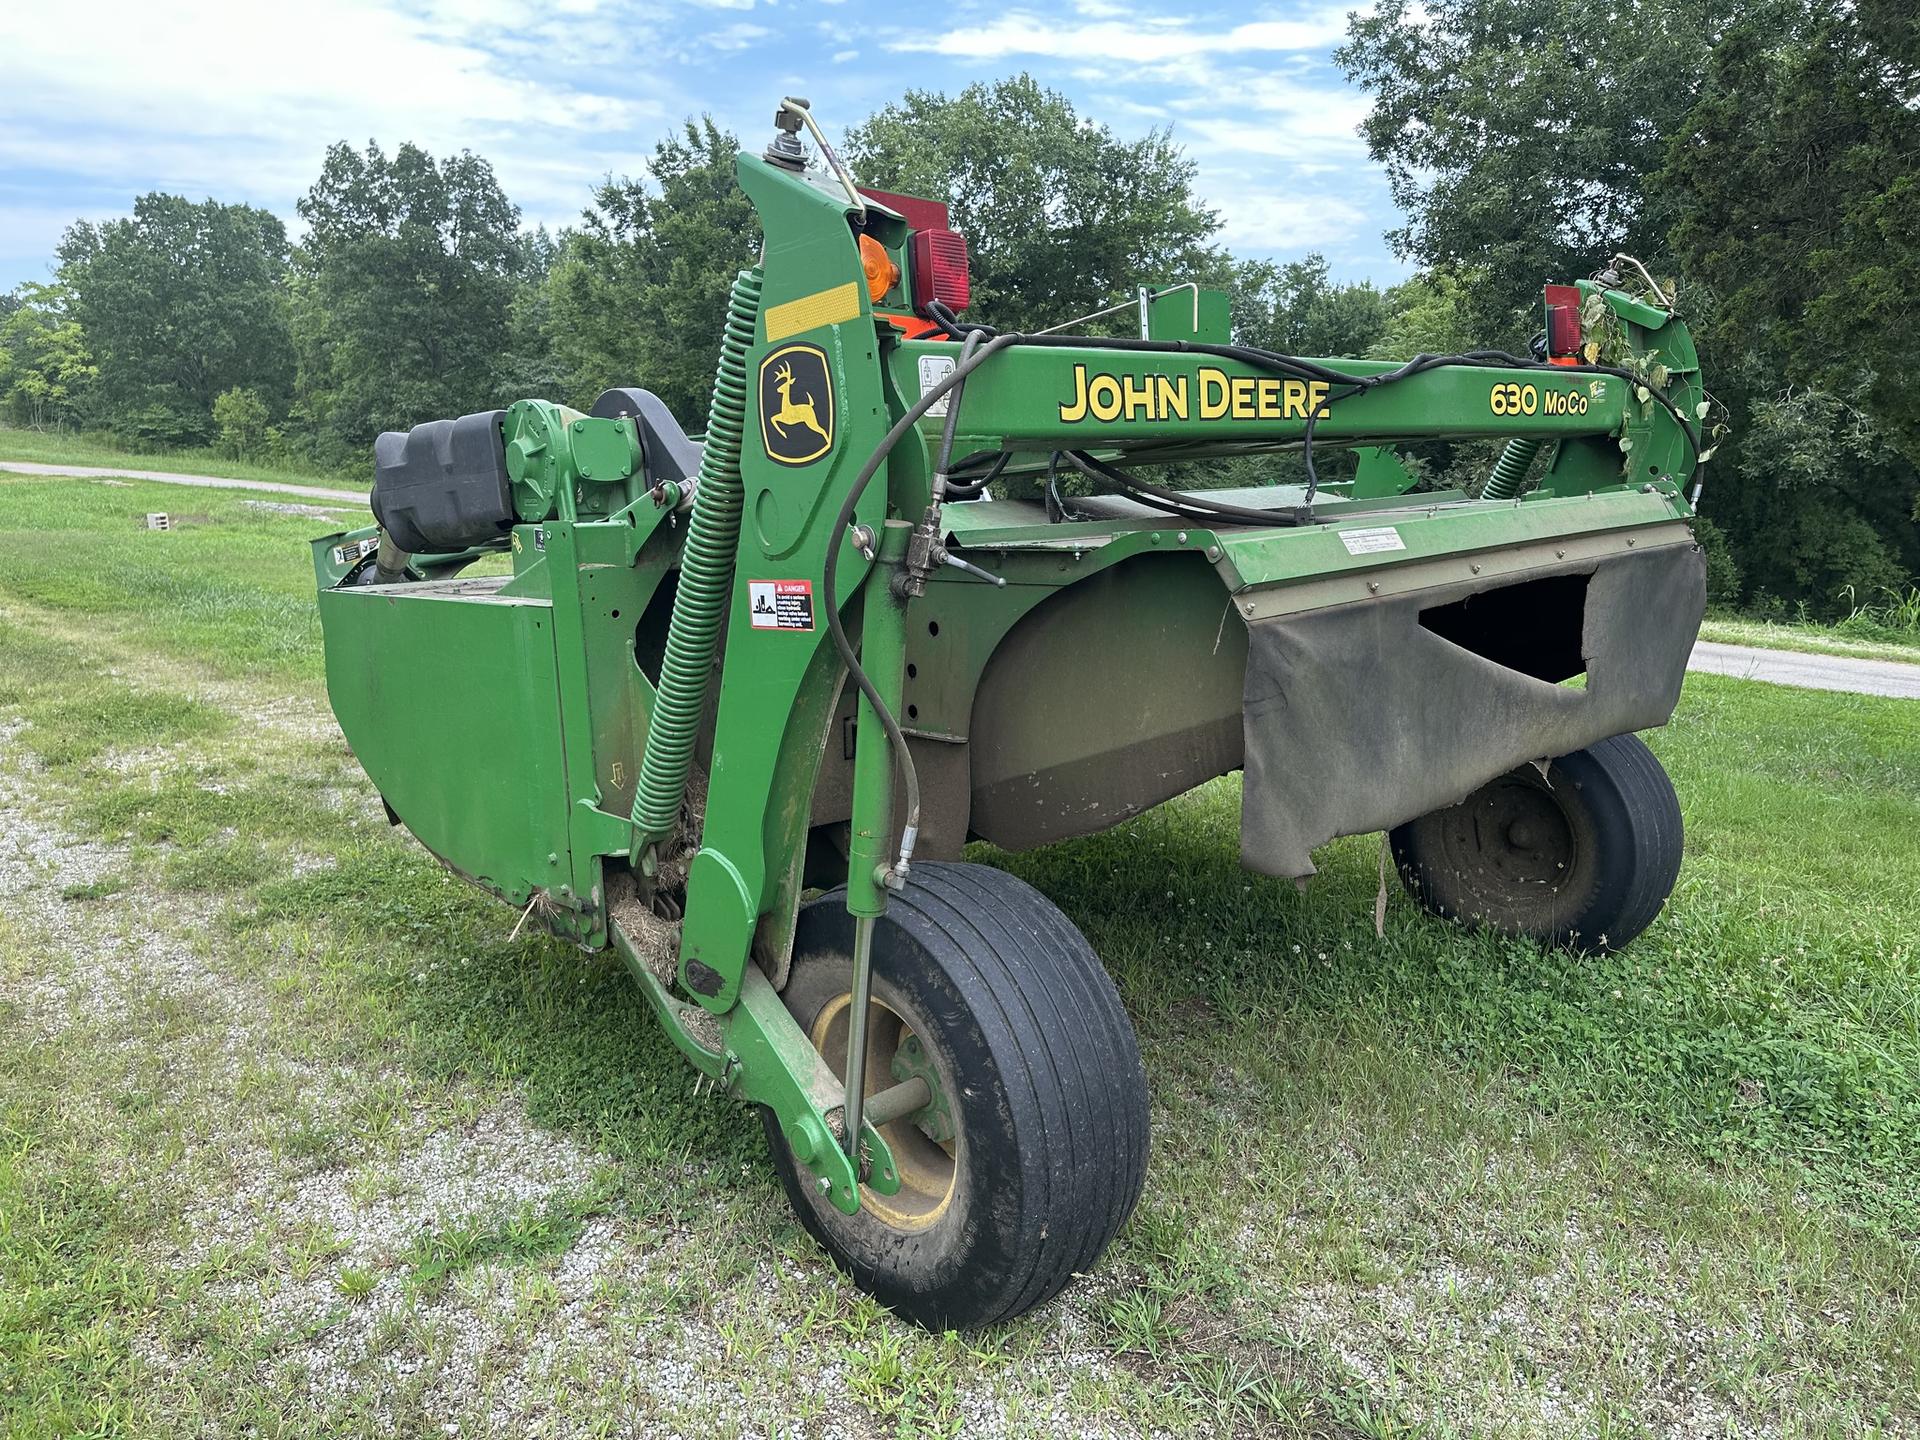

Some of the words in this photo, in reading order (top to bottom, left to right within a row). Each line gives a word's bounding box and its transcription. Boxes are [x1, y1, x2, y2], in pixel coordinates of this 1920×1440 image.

[1059, 364, 1189, 422] JOHN
[1198, 366, 1331, 420] DEERE
[1490, 382, 1538, 416] 630
[1543, 390, 1589, 416] MoCo
